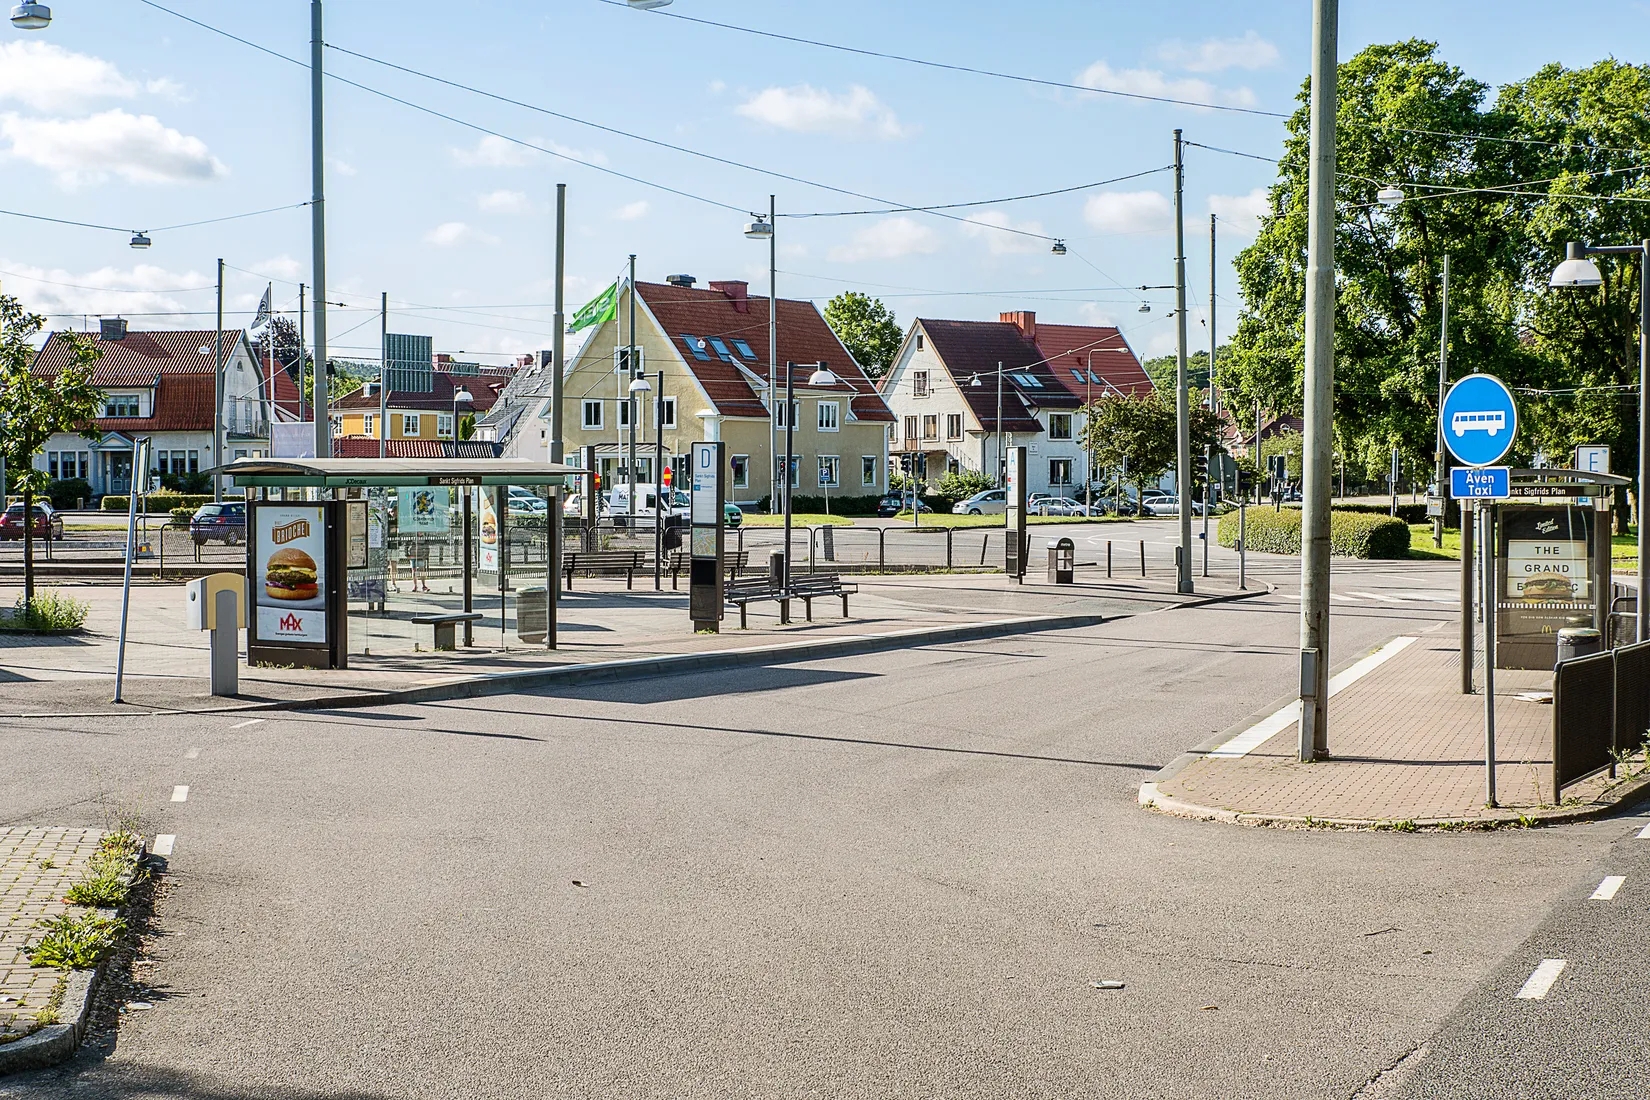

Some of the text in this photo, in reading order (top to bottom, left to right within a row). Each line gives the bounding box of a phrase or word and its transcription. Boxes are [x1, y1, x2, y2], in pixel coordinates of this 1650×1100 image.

[701, 448, 710, 468] D
[1589, 452, 1598, 472] E
[439, 477, 450, 485] Sankt
[451, 477, 465, 486] Sigfrids
[1465, 470, 1495, 484] Även
[1468, 484, 1492, 495] Taxi
[1524, 487, 1549, 496] Sigfrids
[1551, 487, 1566, 495] Plan
[276, 522, 305, 543] BRIOCHE
[1534, 546, 1560, 555] THE
[1524, 564, 1570, 573] GRAND
[279, 612, 304, 631] MAX
